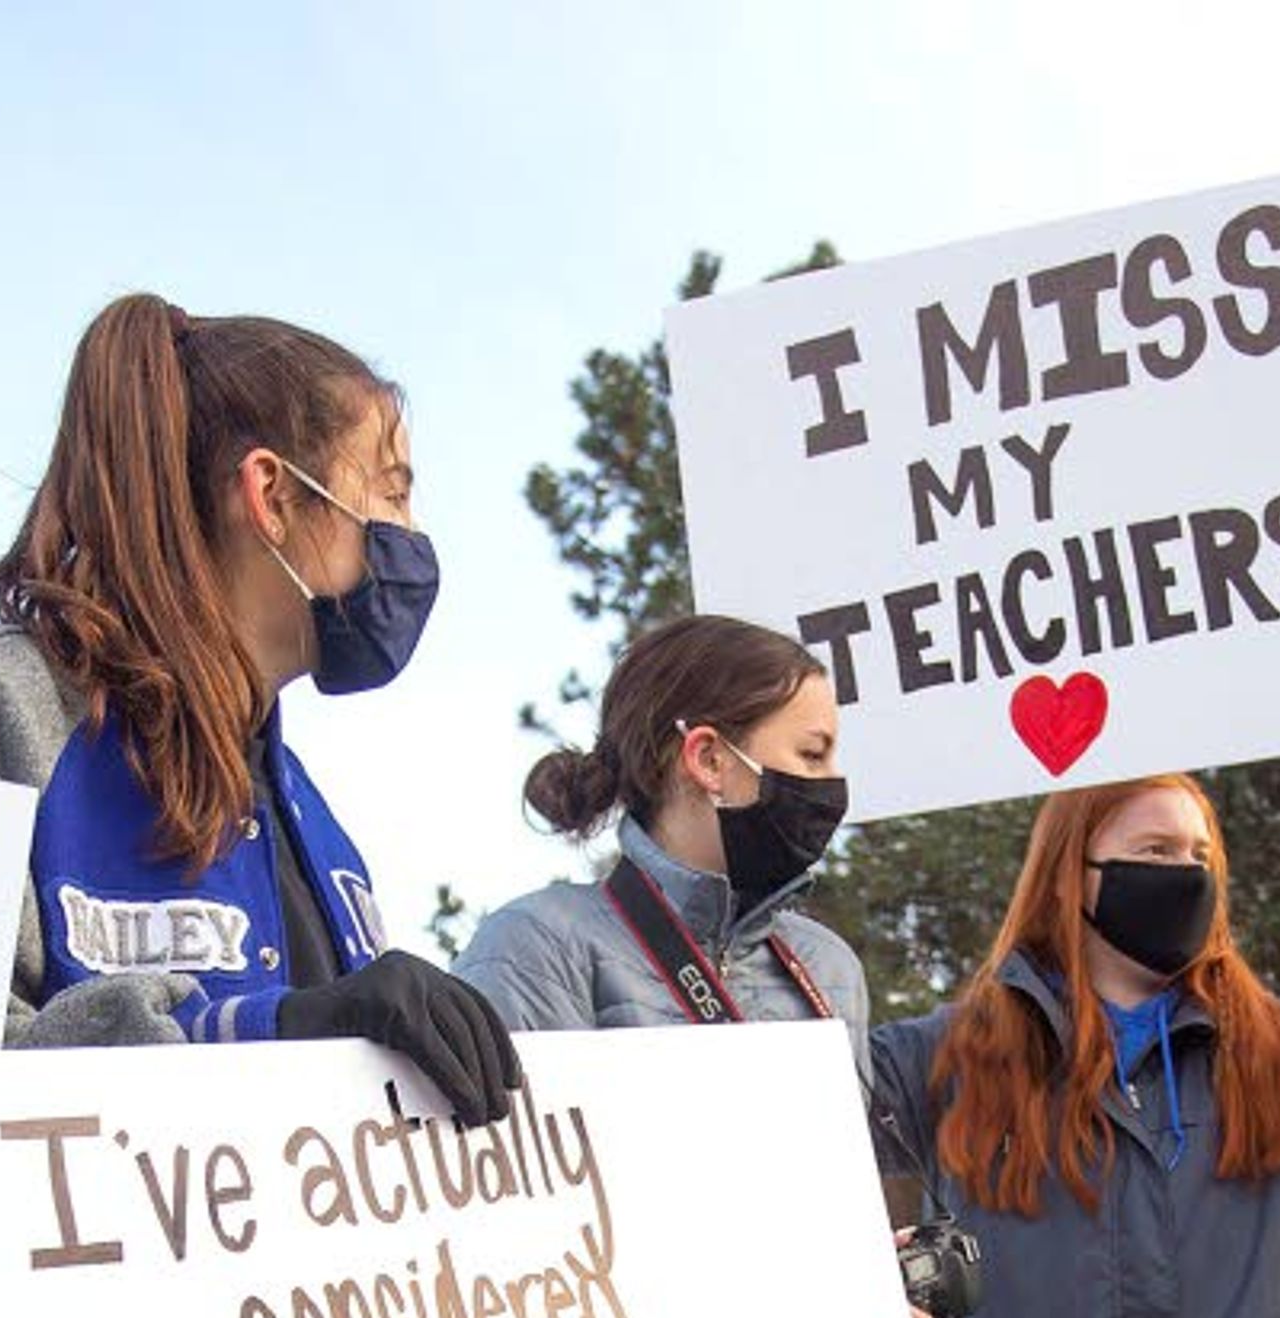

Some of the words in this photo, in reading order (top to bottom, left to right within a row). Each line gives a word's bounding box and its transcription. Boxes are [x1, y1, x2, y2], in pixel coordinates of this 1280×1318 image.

[786, 329, 869, 458] I
[907, 423, 1070, 546] MY
[678, 963, 721, 1019] EOS
[0, 1116, 256, 1270] I've
[284, 1072, 614, 1274] actually
